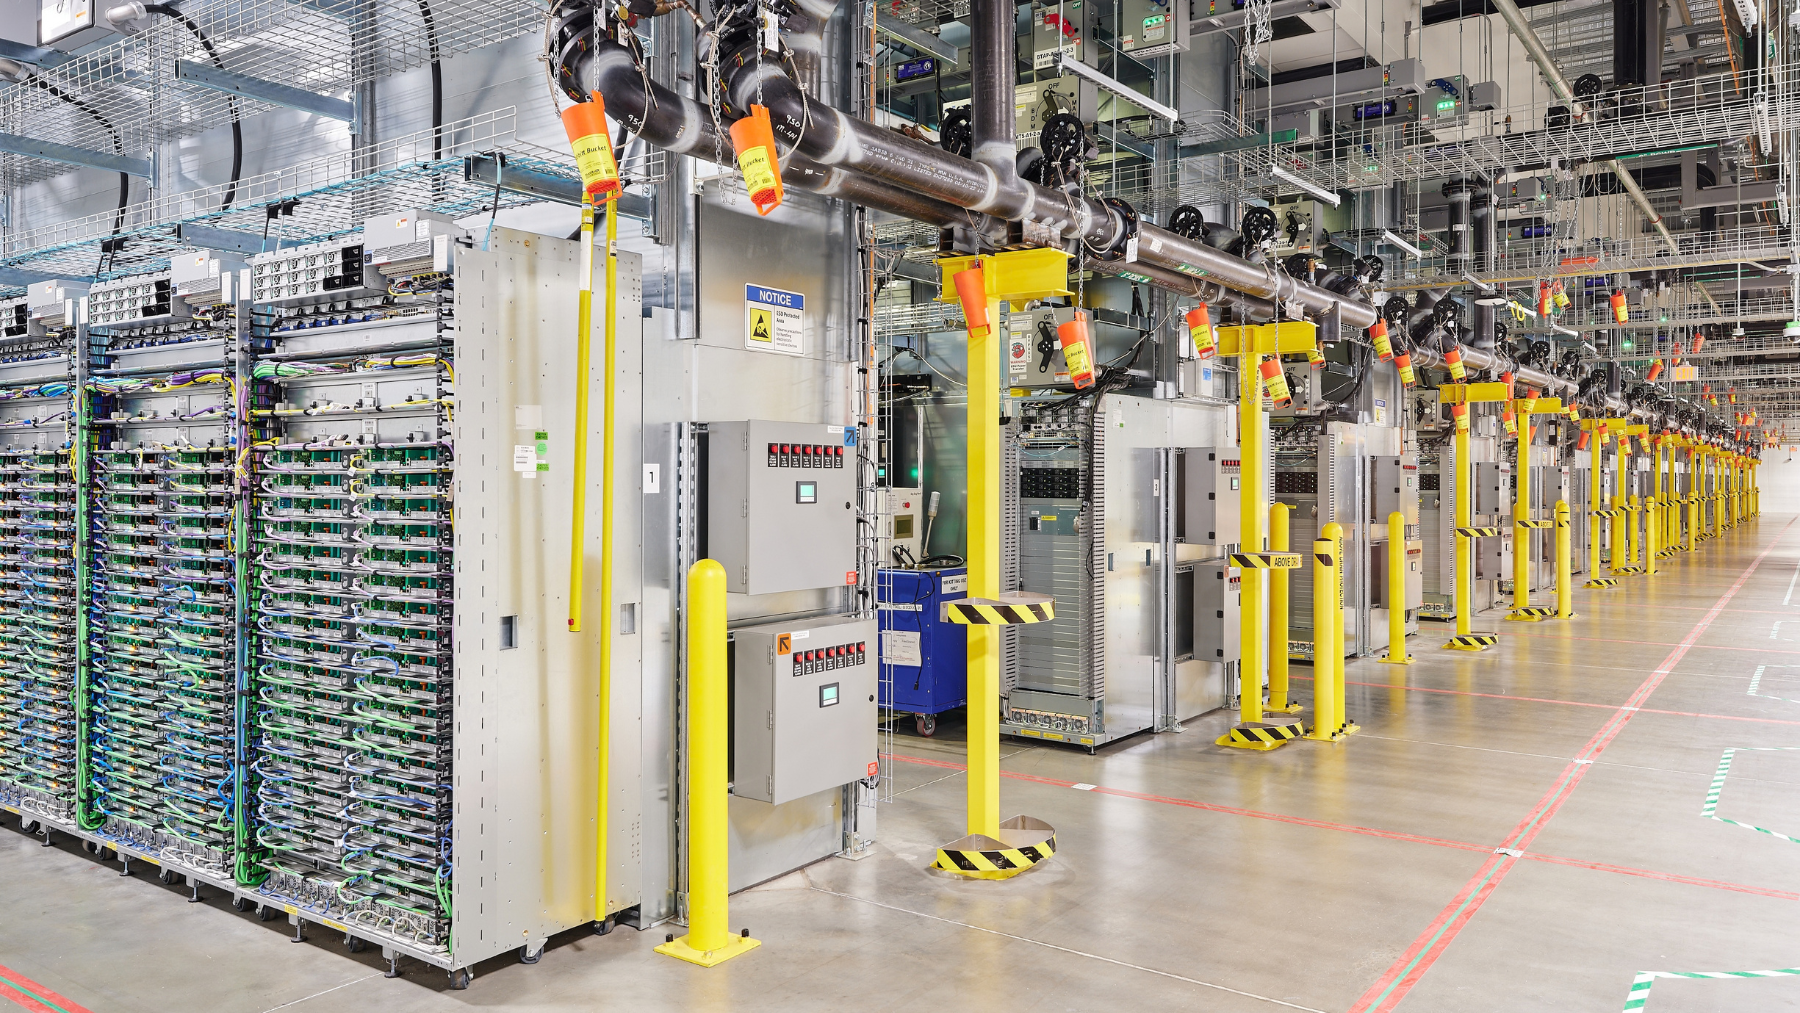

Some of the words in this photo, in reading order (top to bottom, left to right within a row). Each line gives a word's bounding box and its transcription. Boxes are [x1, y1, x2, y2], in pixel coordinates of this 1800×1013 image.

[586, 145, 607, 154] Bucket
[760, 290, 792, 306] NOTICE
[1676, 368, 1694, 380] EXIT
[650, 472, 654, 484] 1
[1274, 557, 1290, 566] ABOVE
